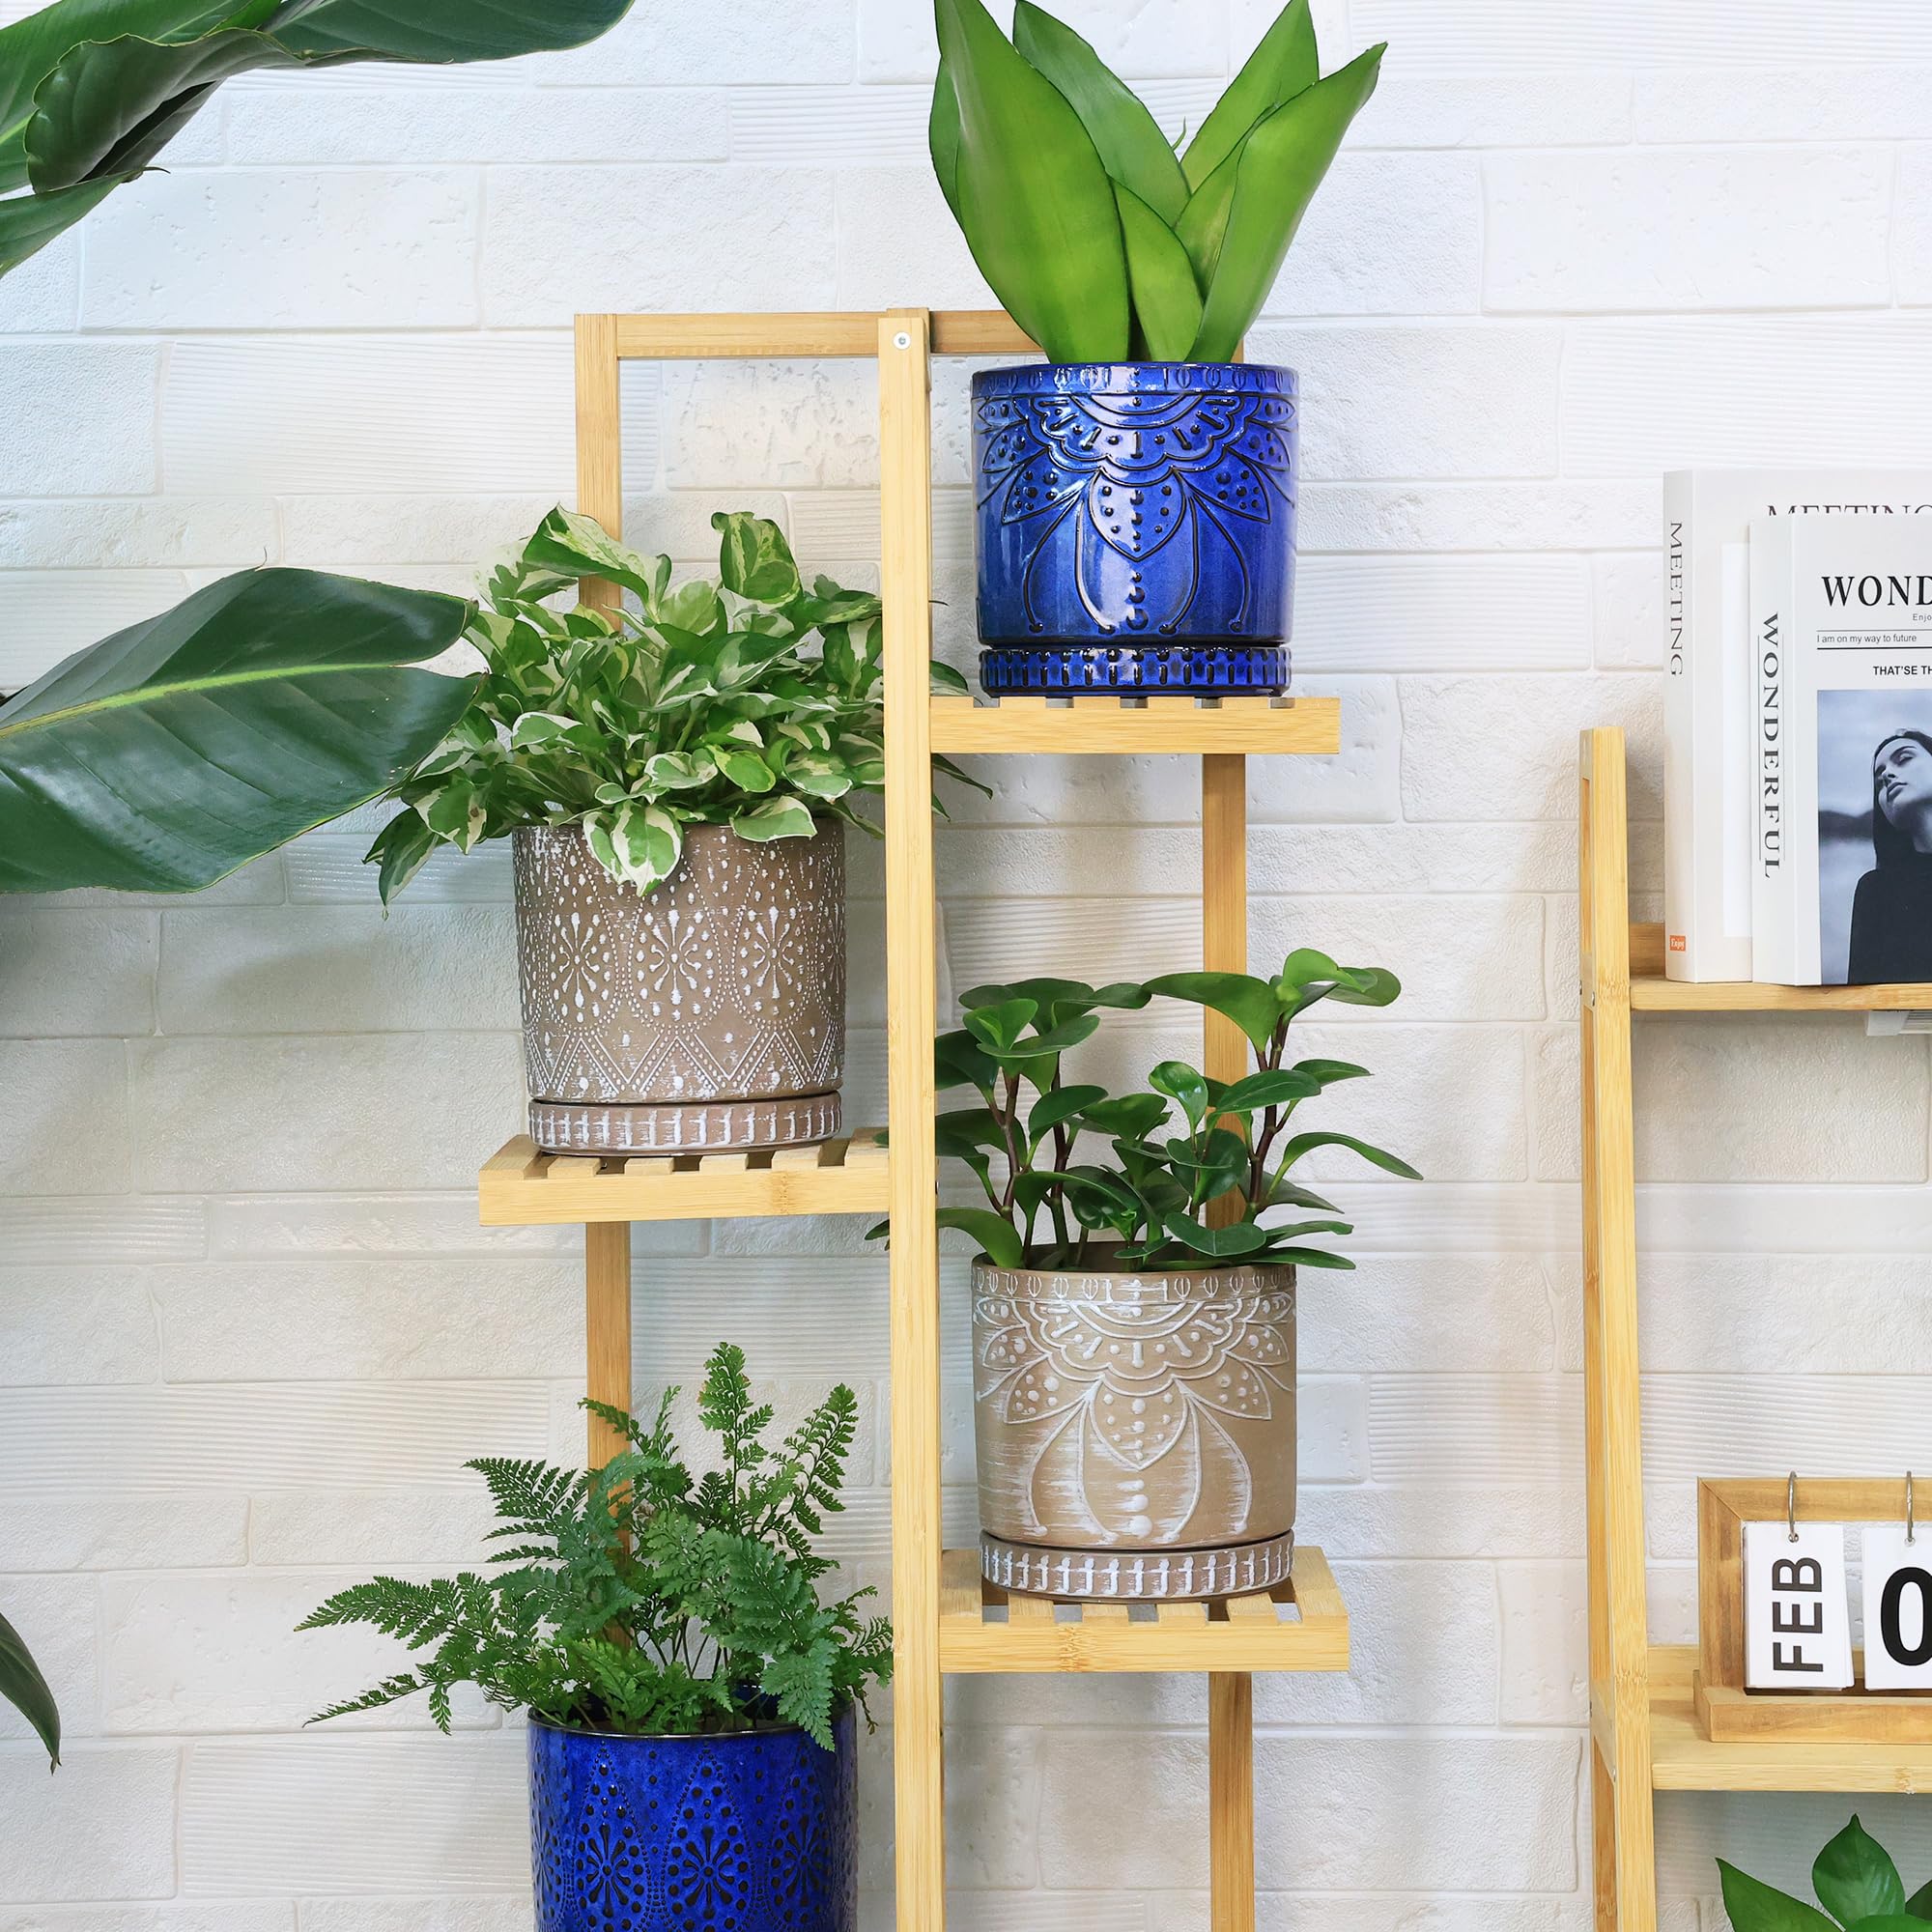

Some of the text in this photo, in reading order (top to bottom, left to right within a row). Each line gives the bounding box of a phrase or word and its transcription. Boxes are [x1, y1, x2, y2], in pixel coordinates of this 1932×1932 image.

[1670, 523, 1683, 676] MEETING
[1849, 636, 1862, 644] my
[1863, 636, 1882, 644] way
[1893, 634, 1918, 642] future
[1763, 612, 1780, 878] WONDERFUL
[1772, 1557, 1824, 1673] FEB
